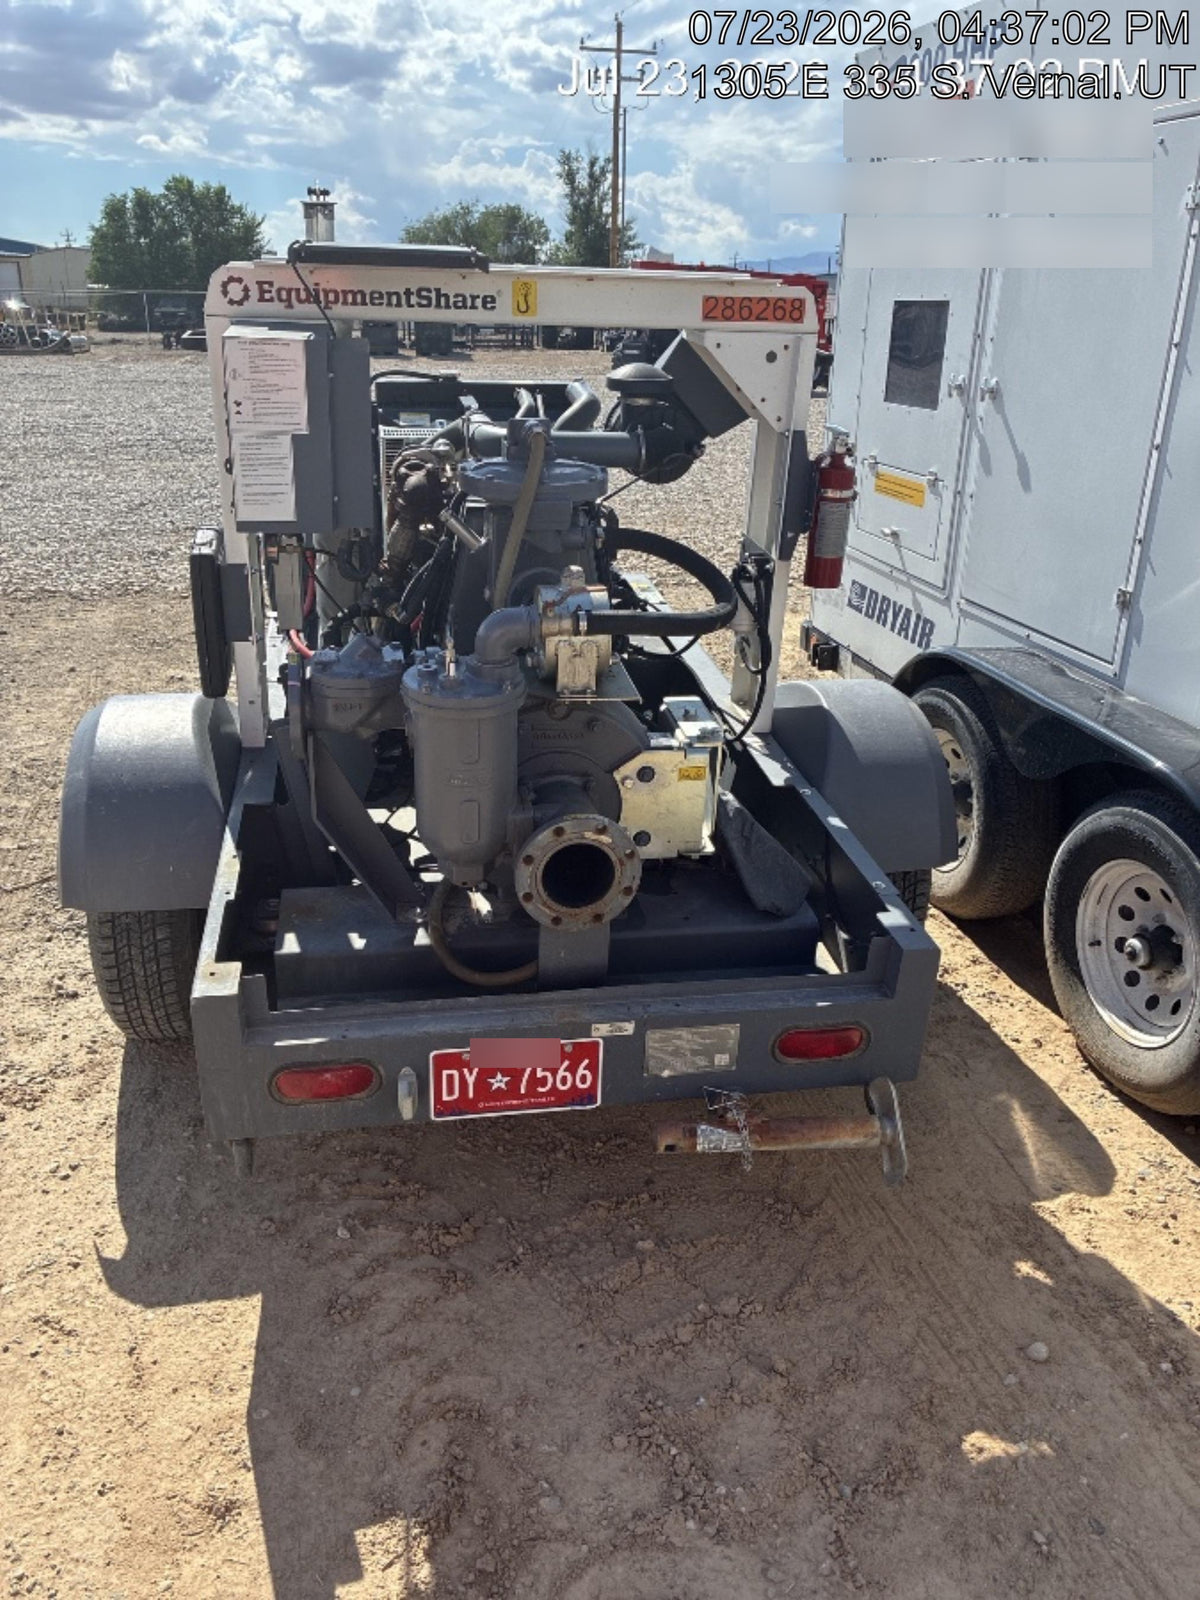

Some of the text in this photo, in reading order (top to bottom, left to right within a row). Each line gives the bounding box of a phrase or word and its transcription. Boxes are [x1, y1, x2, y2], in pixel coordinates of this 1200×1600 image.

[256, 281, 497, 311] EquipmentShare
[704, 296, 803, 321] 286268
[864, 588, 936, 650] DRYAIR
[442, 1067, 479, 1101] DY
